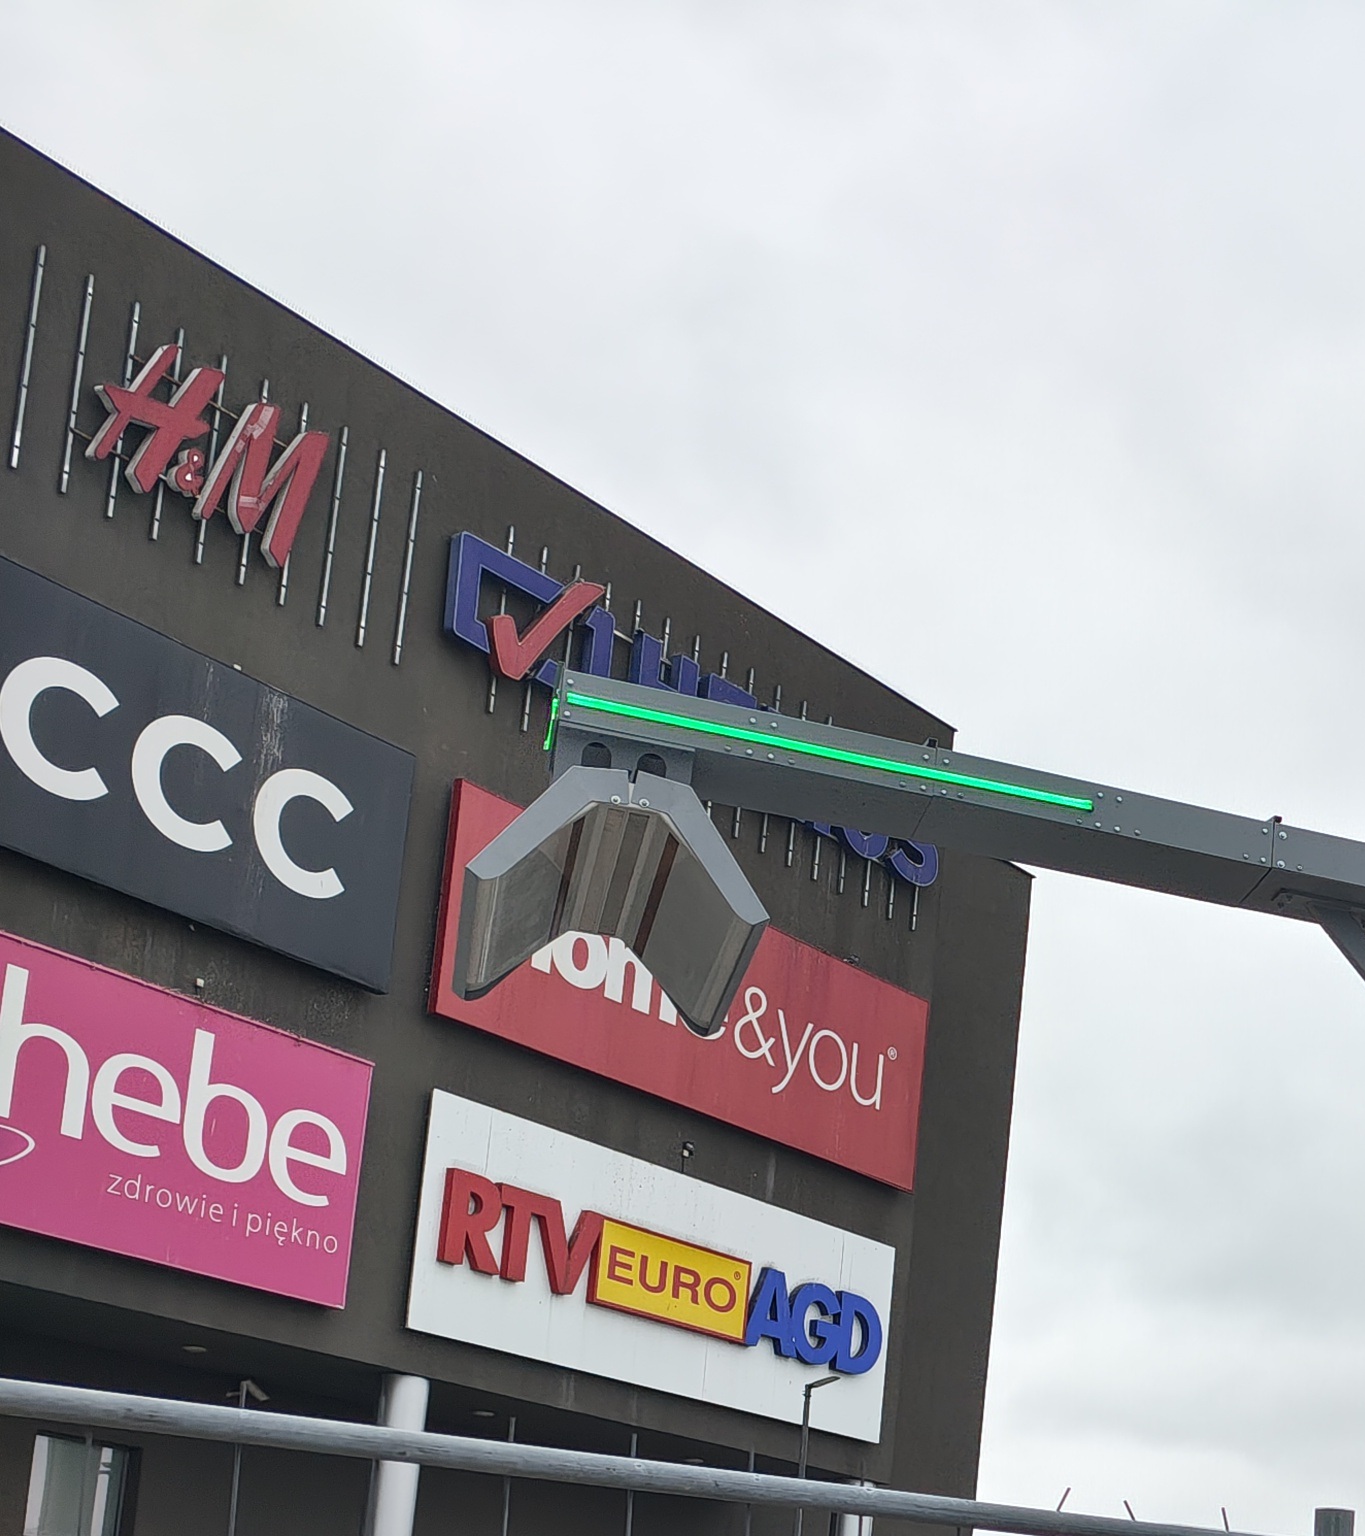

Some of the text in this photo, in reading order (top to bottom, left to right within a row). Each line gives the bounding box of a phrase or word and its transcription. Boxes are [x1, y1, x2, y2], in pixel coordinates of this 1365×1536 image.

[84, 343, 330, 569] H&M
[0, 656, 354, 899] CCC
[0, 963, 347, 1208] hebe
[106, 1171, 338, 1255] zdrowie i piękno
[437, 1167, 882, 1375] RTV EURO AGD
